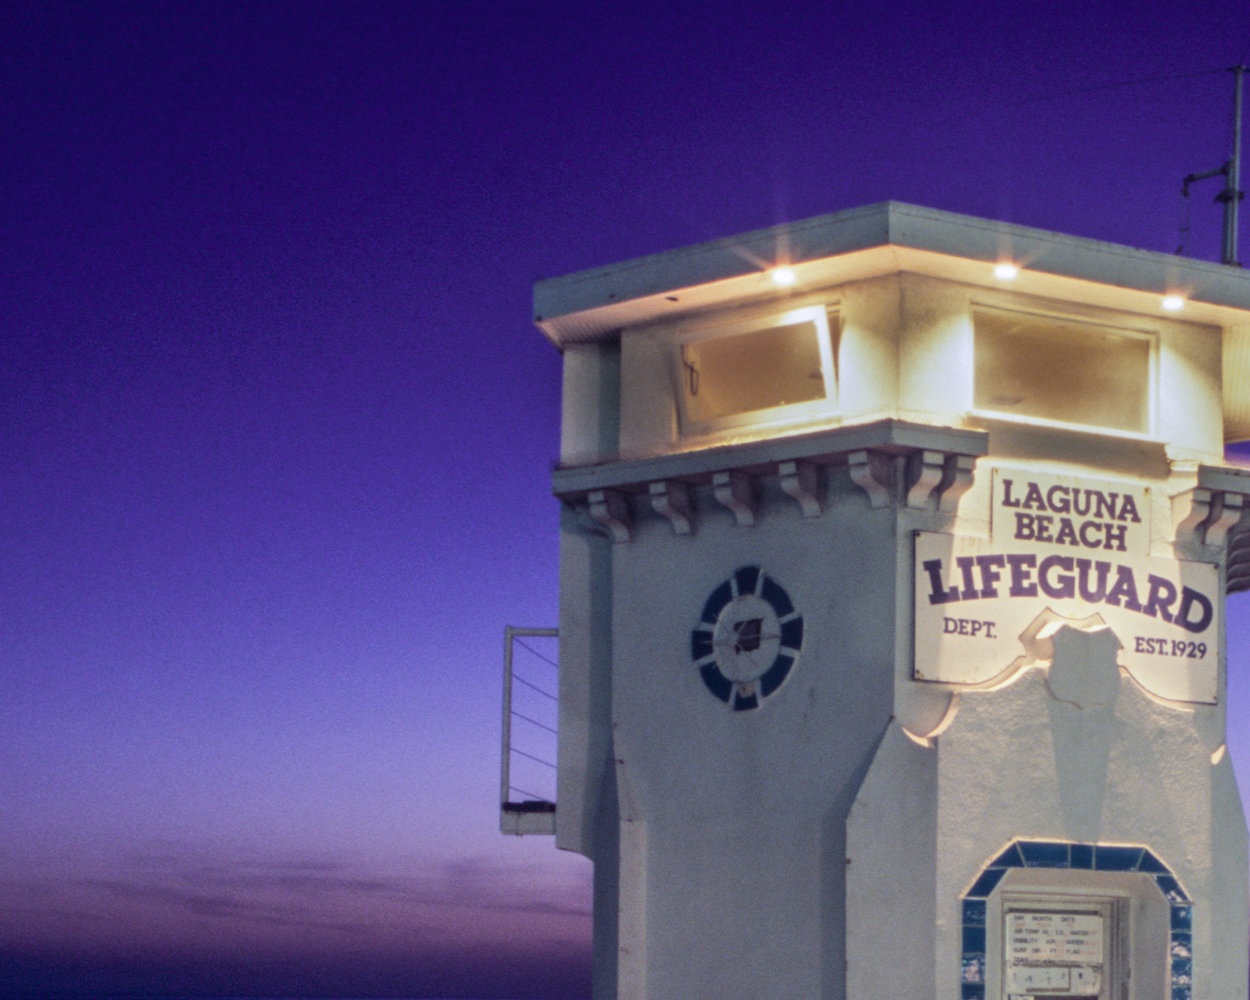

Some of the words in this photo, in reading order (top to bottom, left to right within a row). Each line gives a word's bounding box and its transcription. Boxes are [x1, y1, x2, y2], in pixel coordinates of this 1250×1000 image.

[1001, 478, 1141, 523] LAGUNA
[1014, 511, 1127, 551] BEACH
[922, 553, 1213, 633] LIFEGUARD
[943, 617, 997, 639] DEPT.
